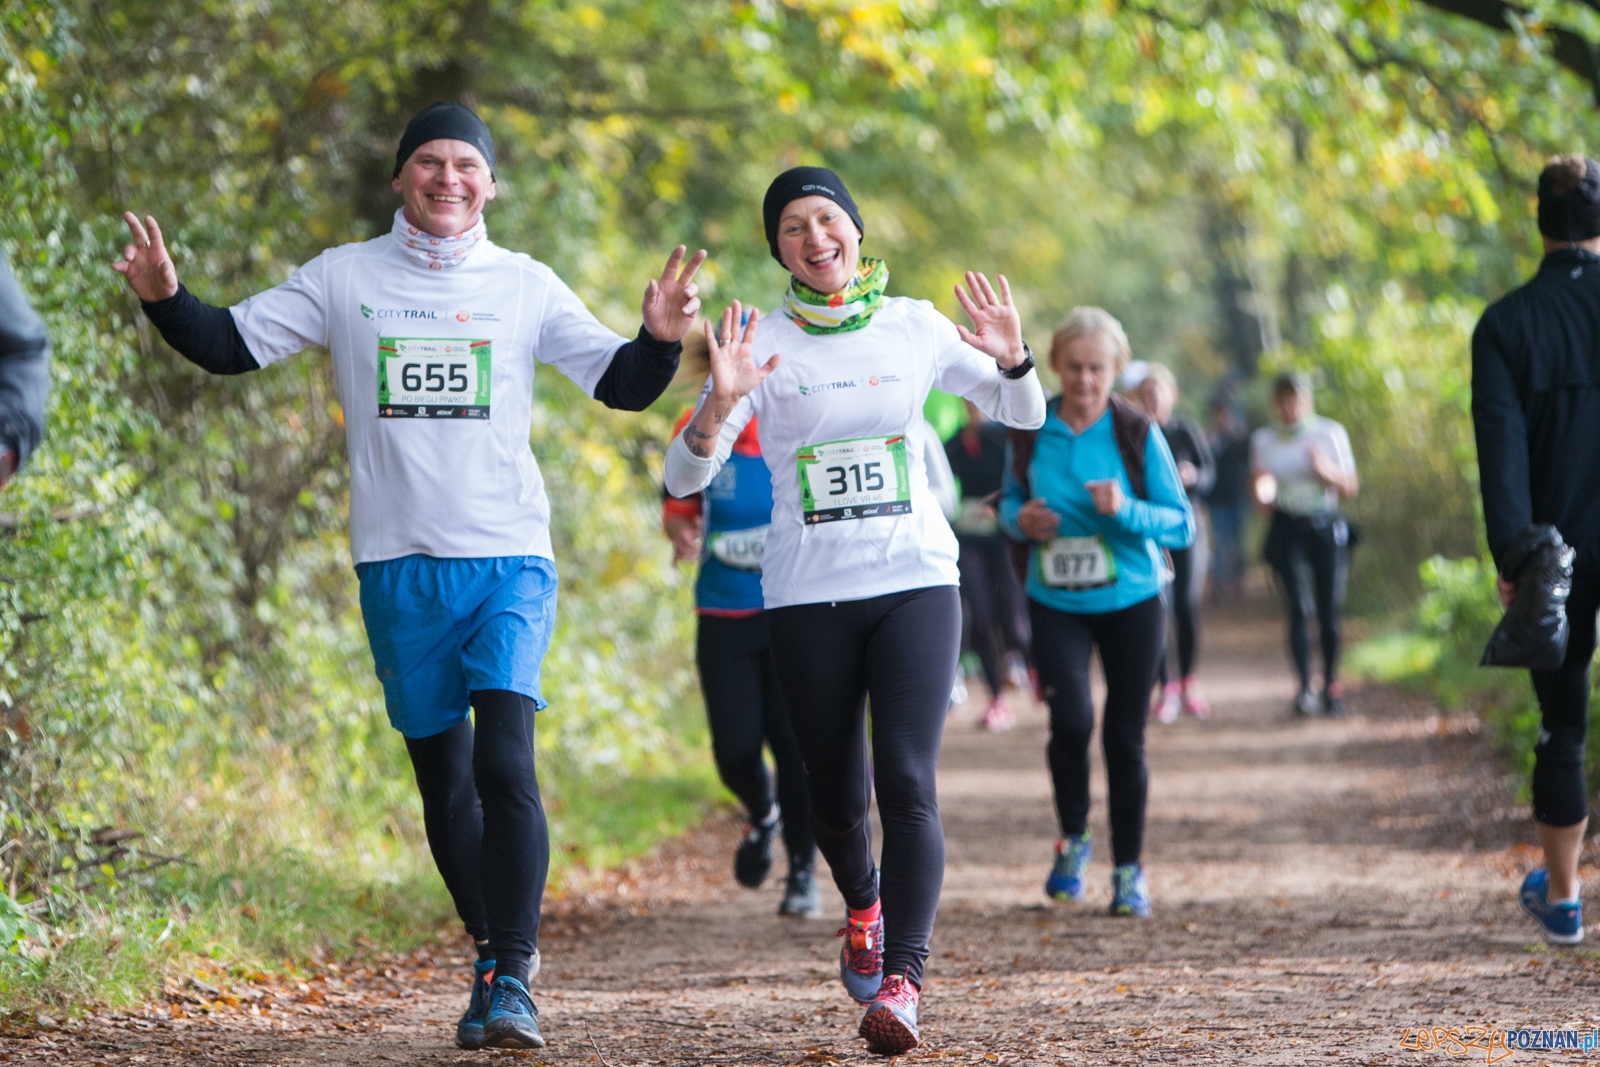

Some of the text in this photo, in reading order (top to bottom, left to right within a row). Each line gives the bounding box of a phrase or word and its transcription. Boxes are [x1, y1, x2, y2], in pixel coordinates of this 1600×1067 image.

[401, 362, 468, 393] 655
[401, 395, 467, 404] PO BIEGU PIWKO!
[826, 461, 884, 496] 315
[838, 496, 859, 506] LOVE
[860, 495, 872, 503] VR
[872, 493, 883, 502] 46
